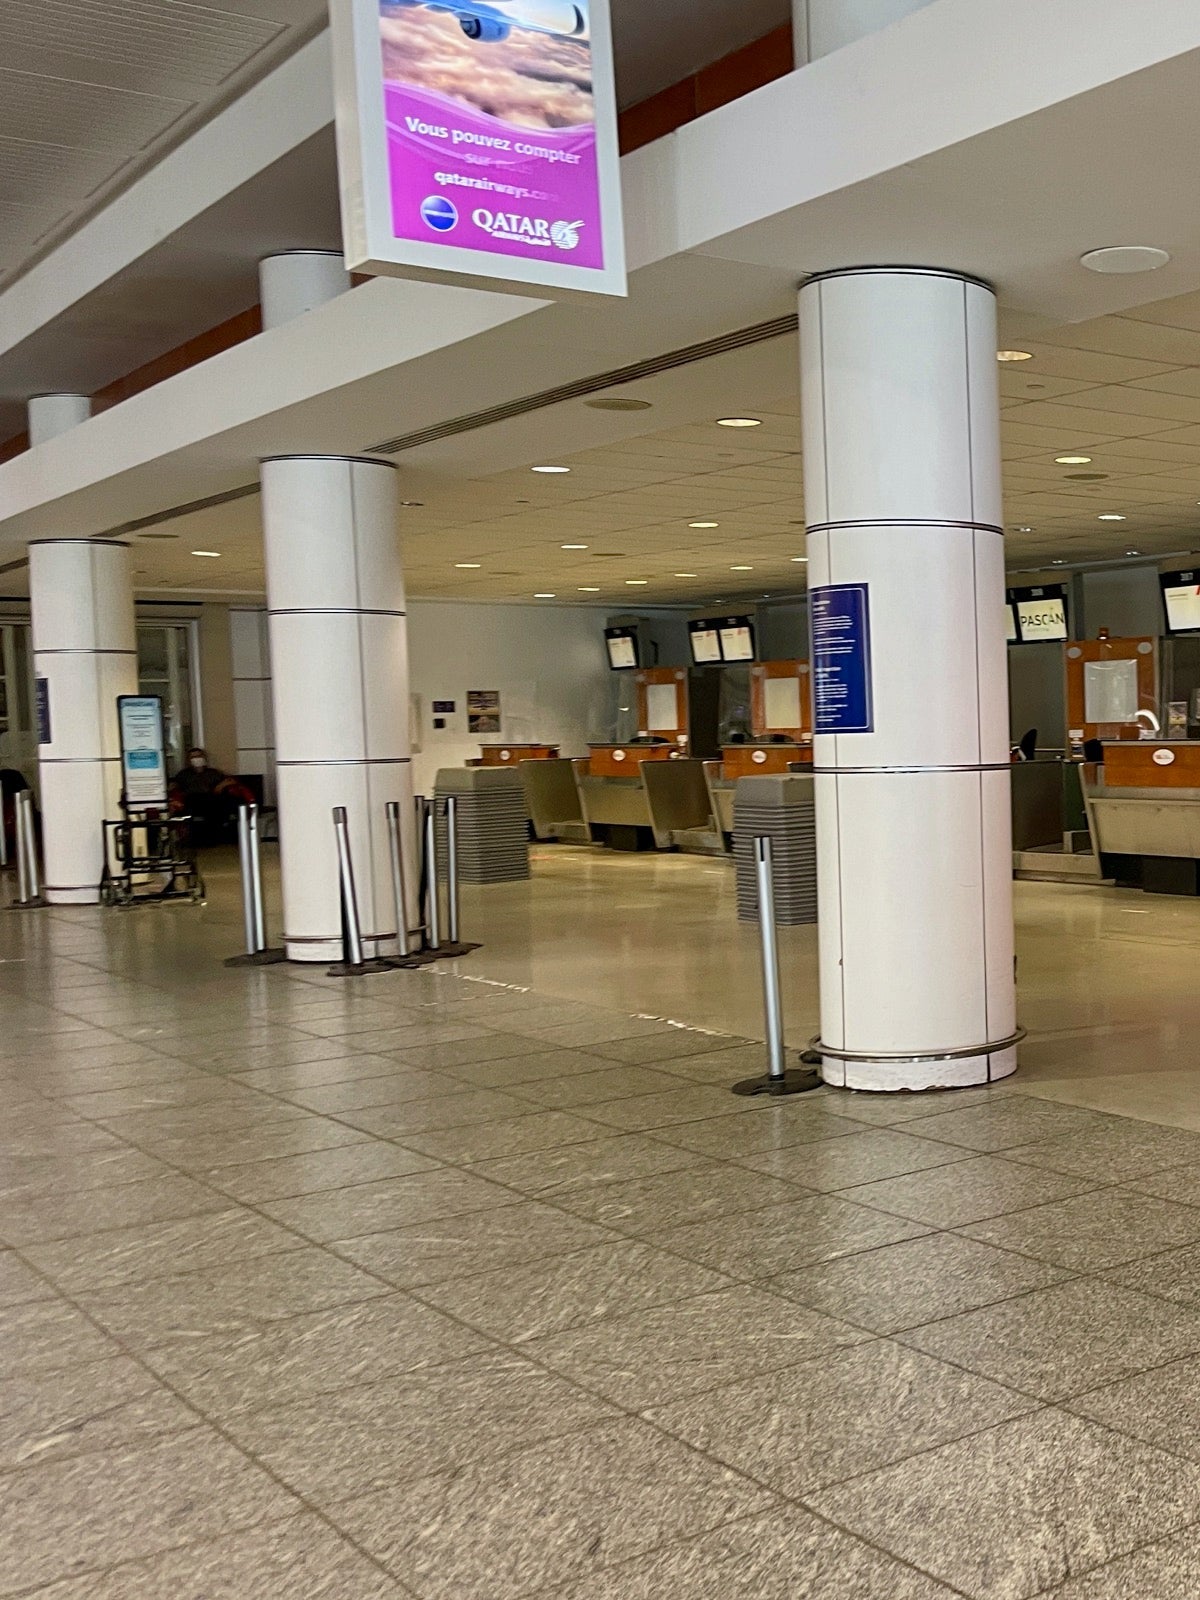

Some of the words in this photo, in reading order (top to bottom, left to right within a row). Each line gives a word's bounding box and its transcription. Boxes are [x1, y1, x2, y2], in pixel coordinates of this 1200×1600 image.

[405, 116, 448, 139] Vous
[452, 130, 511, 152] pouvez
[514, 141, 581, 165] compter
[472, 208, 550, 239] QATAR
[1020, 612, 1064, 627] PASCAN
